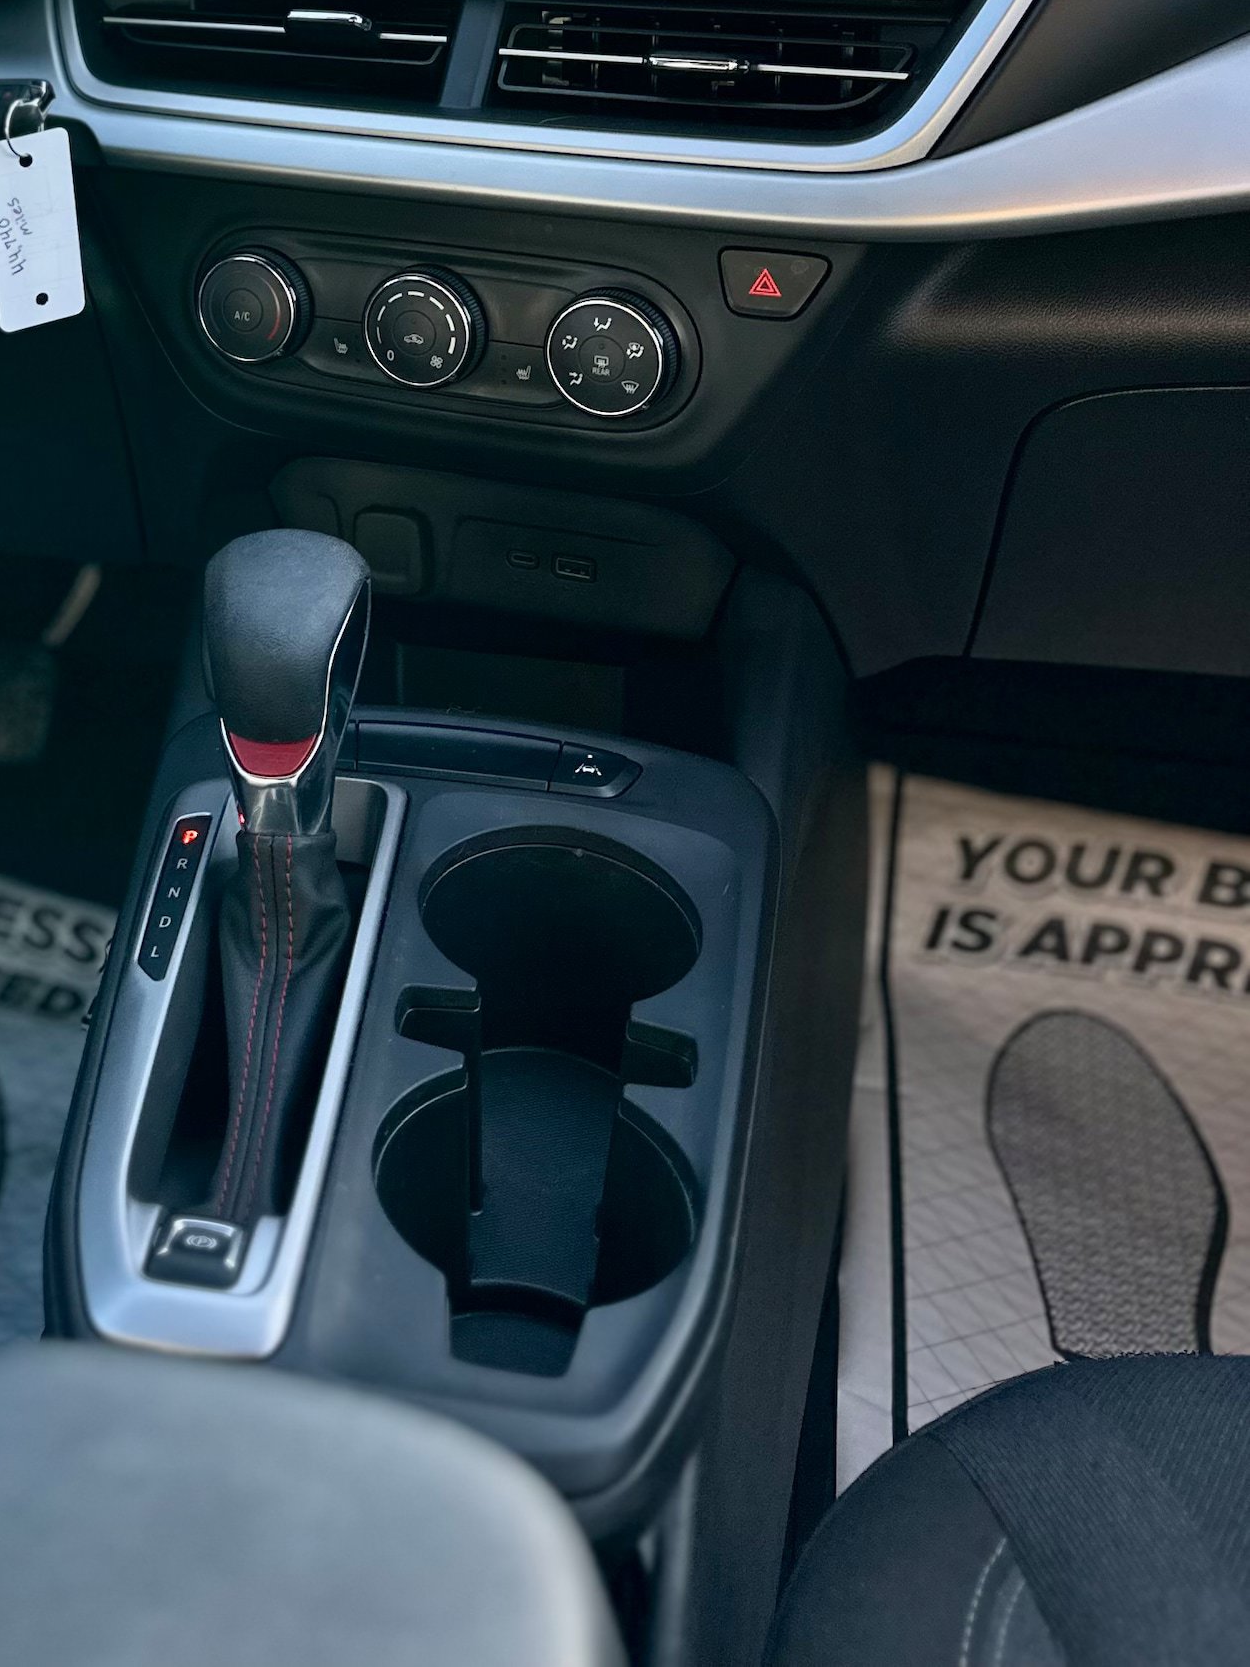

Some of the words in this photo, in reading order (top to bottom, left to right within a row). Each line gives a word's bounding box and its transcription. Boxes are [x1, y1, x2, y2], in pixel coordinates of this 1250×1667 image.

[234, 310, 251, 322] A/C
[592, 367, 610, 377] REAR
[182, 830, 199, 845] P
[176, 857, 188, 870] R
[956, 835, 1176, 898] YOUR
[167, 887, 181, 898] N
[158, 916, 172, 929] D
[150, 946, 160, 958] L
[925, 906, 999, 953] IS
[1017, 915, 1250, 995] APPR
